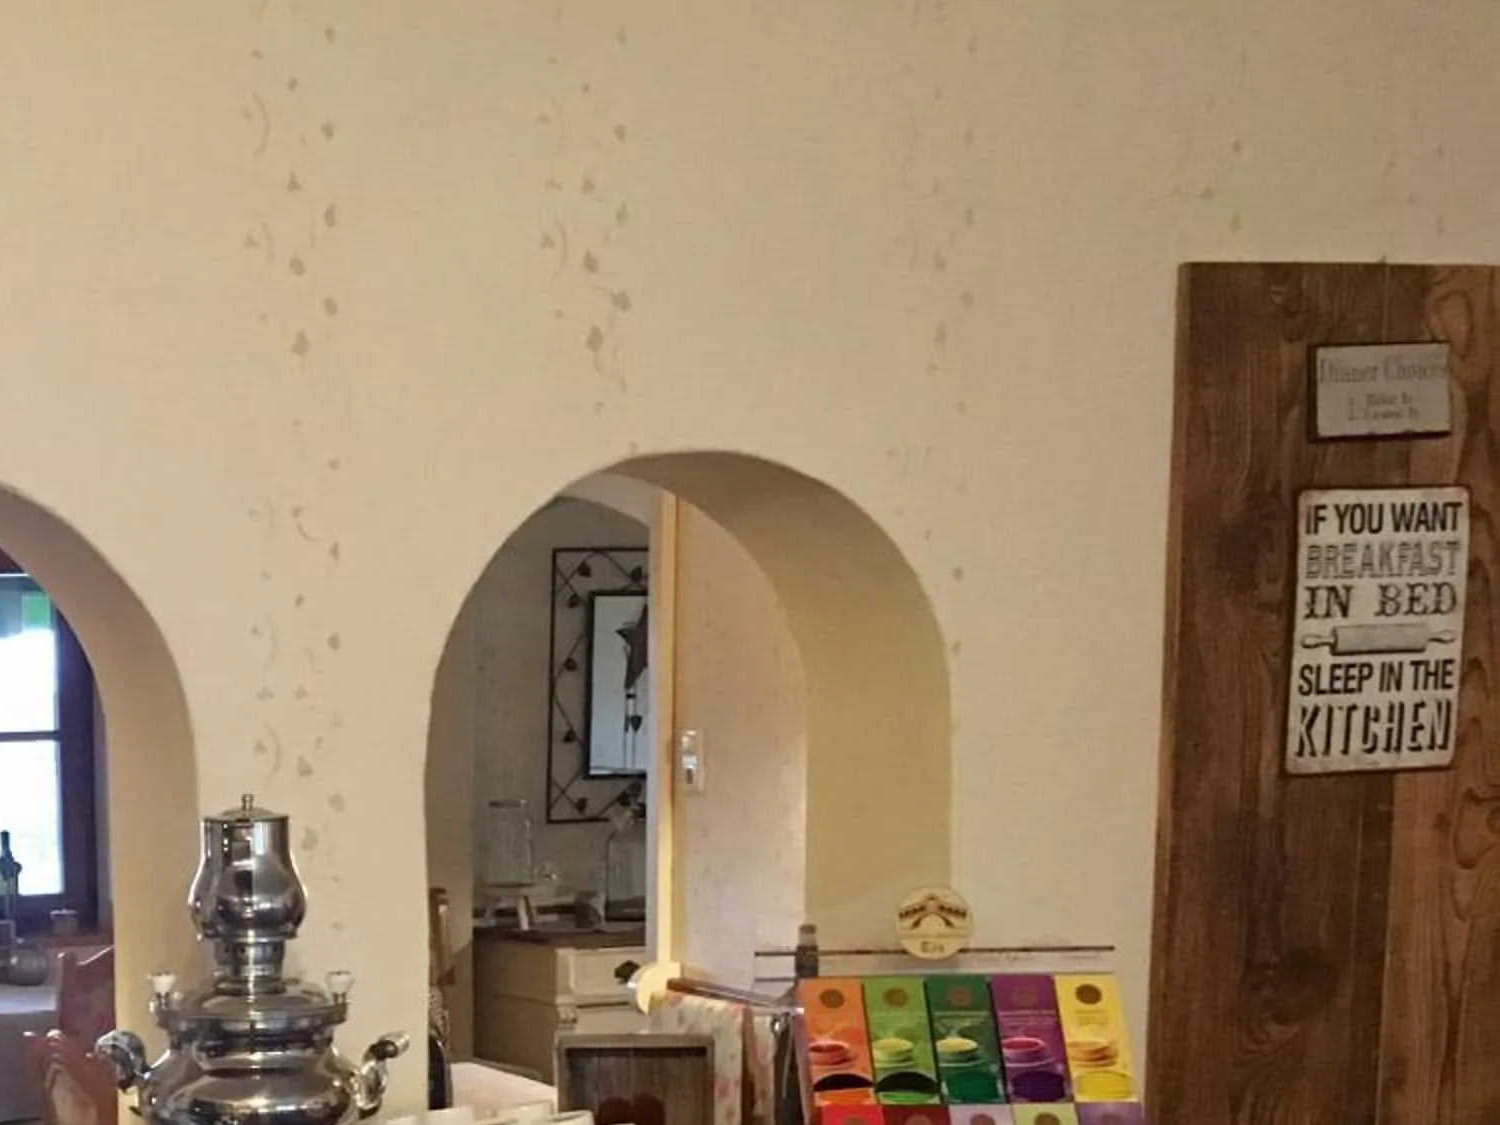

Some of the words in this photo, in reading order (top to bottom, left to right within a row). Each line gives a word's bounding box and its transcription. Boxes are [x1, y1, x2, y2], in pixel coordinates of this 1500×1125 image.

[1305, 504, 1328, 535] IF
[1333, 503, 1384, 534] YOU
[1391, 501, 1463, 533] WANT
[1305, 540, 1461, 579] BREAKFAST
[1304, 584, 1354, 619] IN
[1374, 581, 1458, 617] BED
[1298, 661, 1374, 696] SLEEP
[1379, 660, 1404, 692] IN
[1409, 658, 1455, 691] THE
[1296, 697, 1452, 758] KITCHEN
